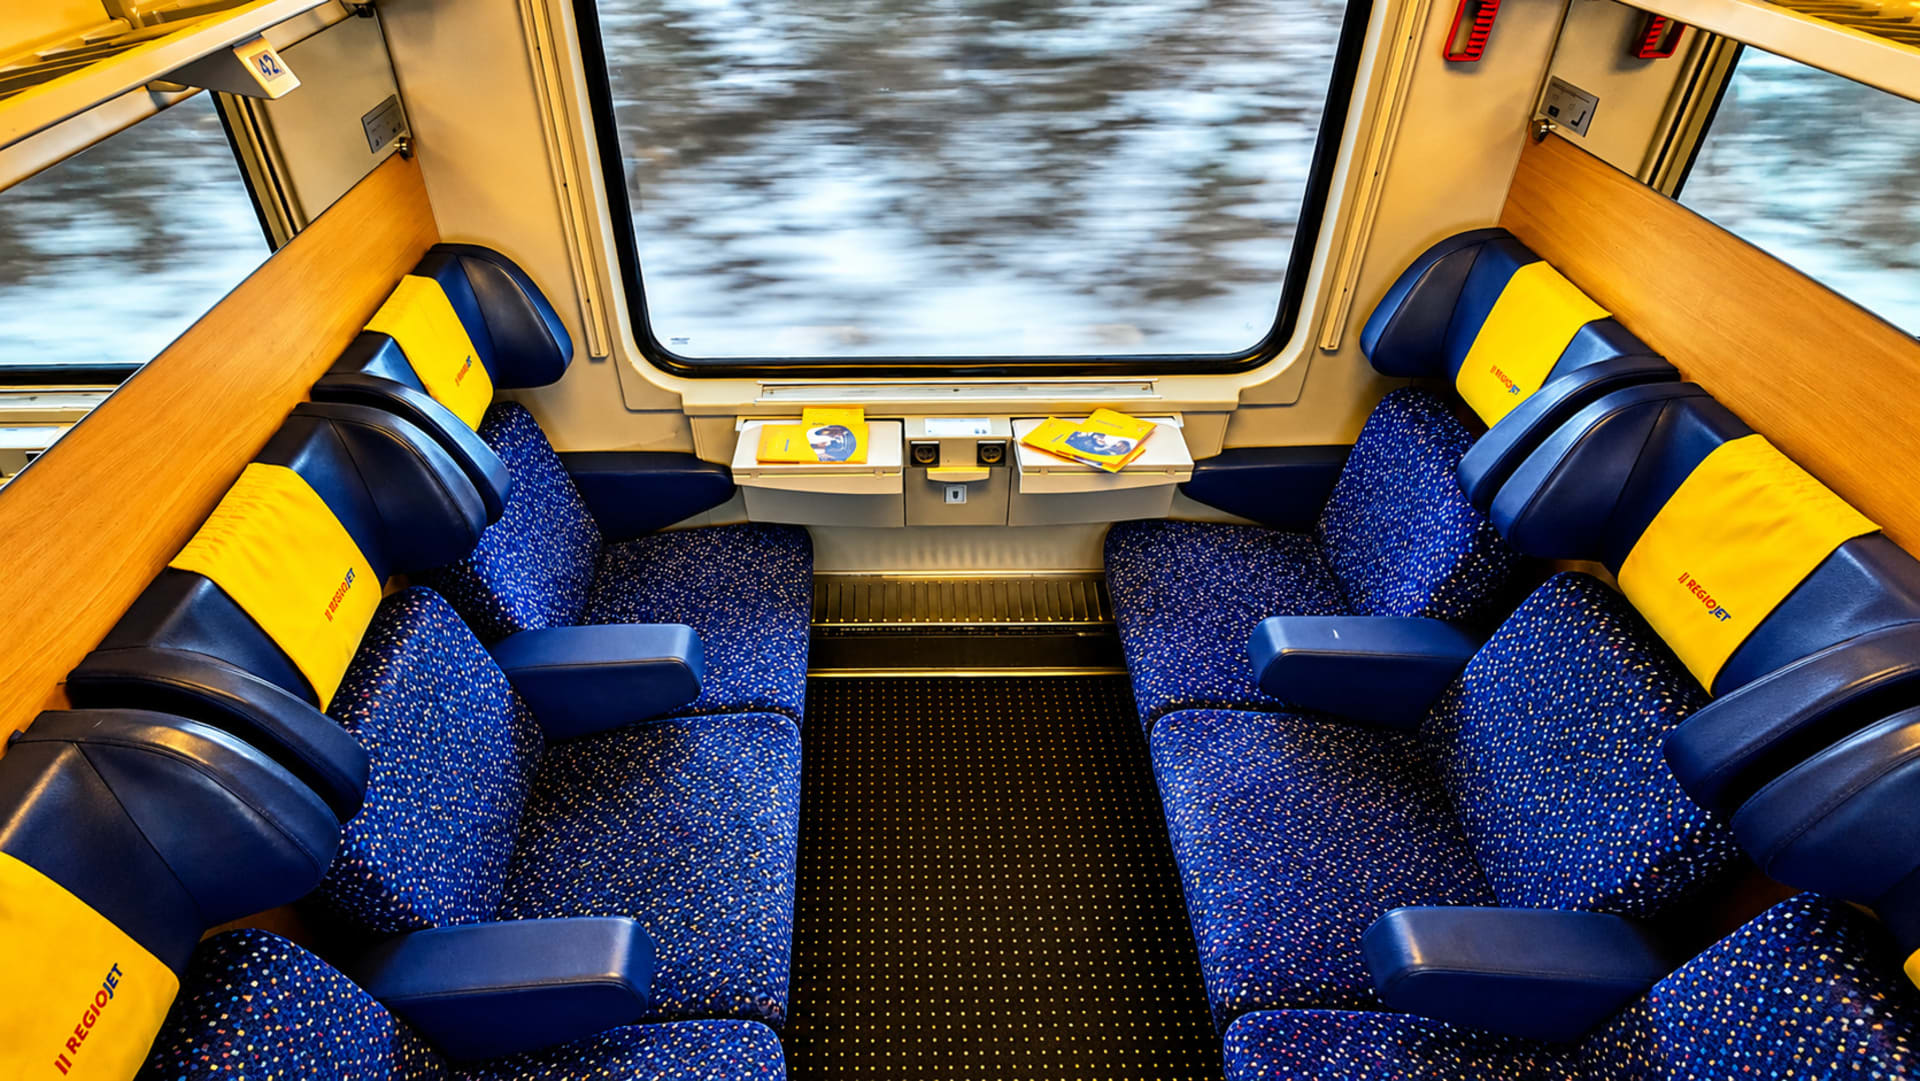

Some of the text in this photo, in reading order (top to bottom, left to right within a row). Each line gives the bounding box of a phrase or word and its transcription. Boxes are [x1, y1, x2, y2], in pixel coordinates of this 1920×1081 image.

[258, 54, 280, 76] 42
[1686, 579, 1731, 621] REGIOJET
[65, 962, 123, 1054] REGIOJET
